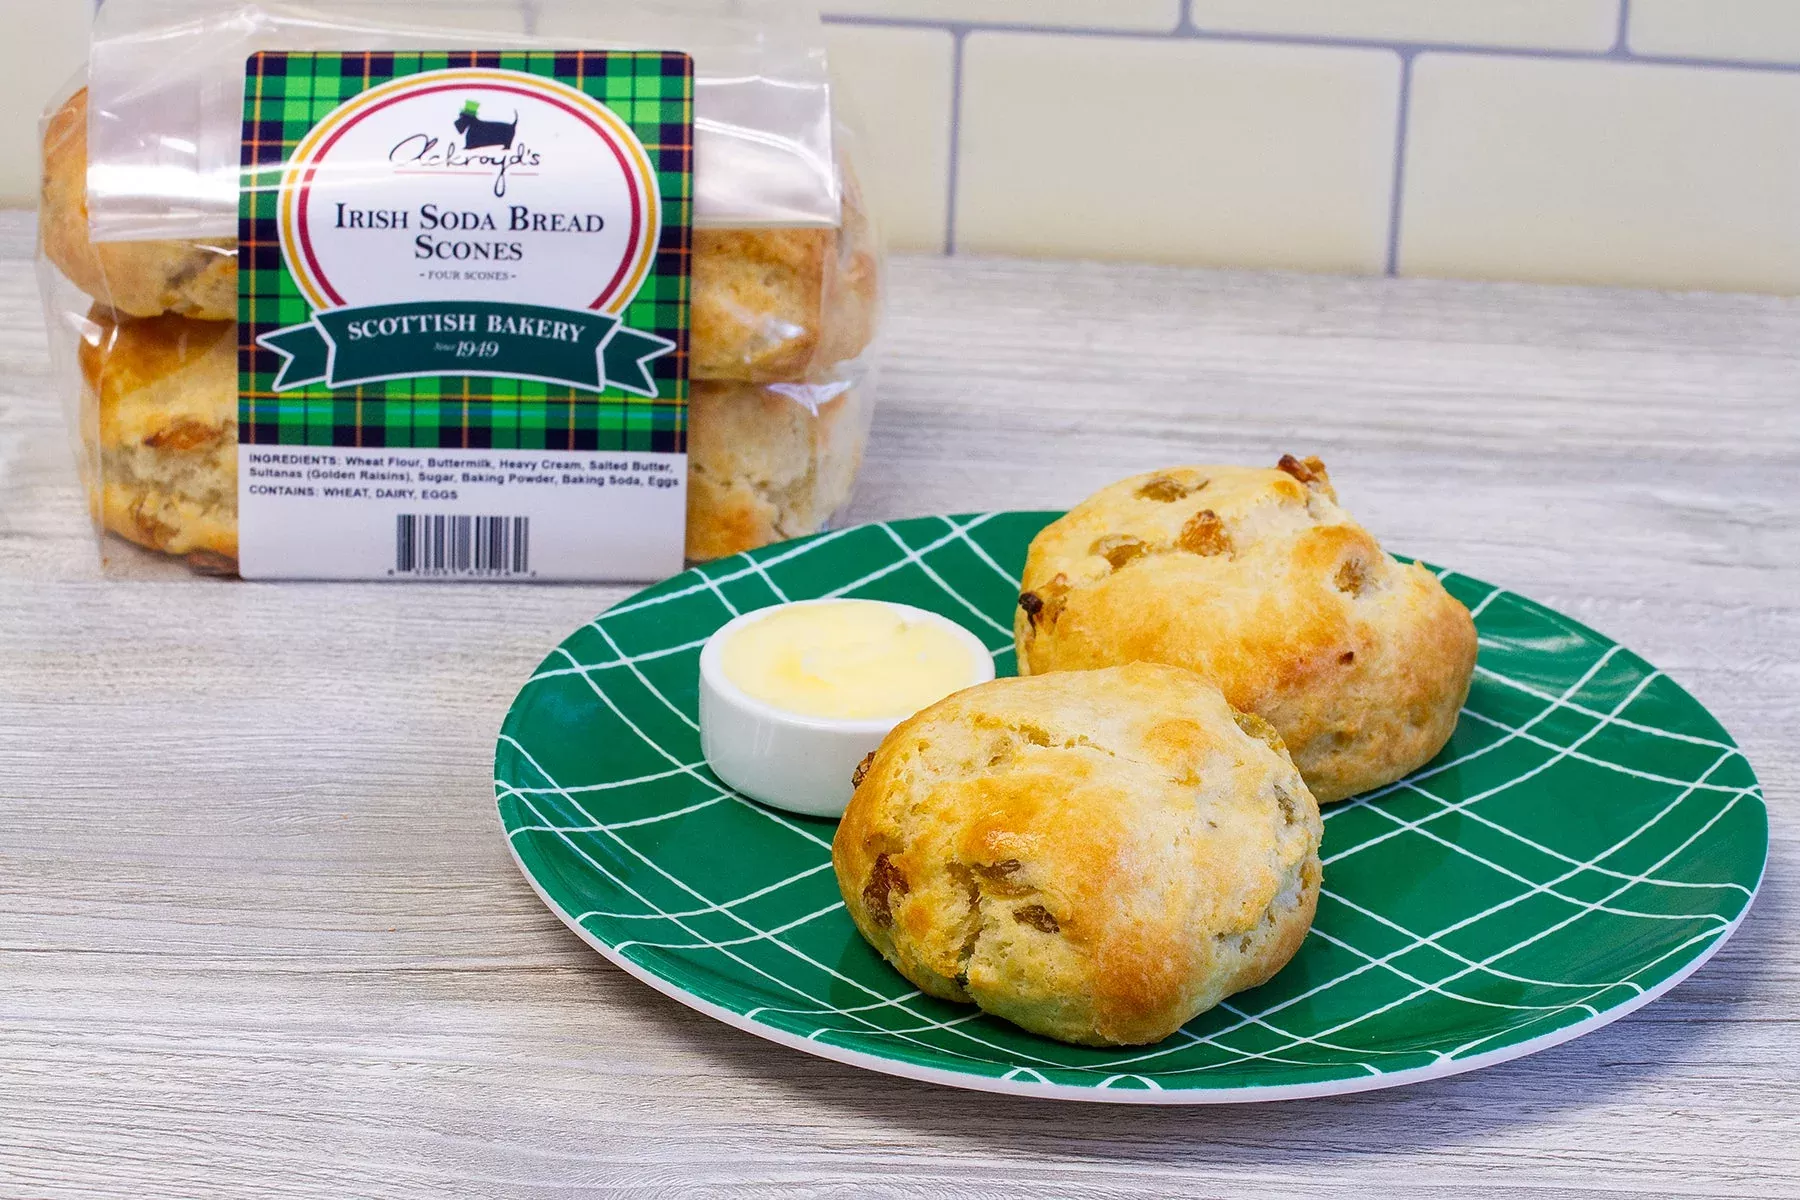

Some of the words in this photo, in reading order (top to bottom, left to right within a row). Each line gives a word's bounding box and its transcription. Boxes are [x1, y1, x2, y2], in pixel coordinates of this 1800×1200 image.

[389, 133, 541, 198] Ackroyd's
[334, 203, 408, 230] IRISH
[419, 203, 496, 231] SODA
[509, 205, 604, 233] BREAD
[415, 234, 523, 261] SCONES
[347, 313, 477, 341] SCOTTISH
[487, 314, 587, 343] BAKERY
[456, 340, 499, 358] 1949
[249, 453, 341, 466] INGREDIENTS:
[346, 456, 384, 467] Wheat
[388, 456, 425, 469] Flour,
[428, 457, 495, 470] Buttermilk,
[500, 459, 537, 471] Heavy
[541, 459, 585, 471] Cream,
[589, 460, 628, 471] Salted
[632, 461, 674, 473] Butter,
[249, 468, 303, 478] Sultanas
[307, 469, 355, 481] (Golden
[360, 470, 414, 483] Raisins),
[418, 471, 457, 484] Sugar,
[462, 473, 504, 485] Baking
[508, 473, 559, 486] Powder,
[562, 474, 605, 487] Baking
[609, 475, 644, 487] Soda,
[648, 476, 680, 488] Eggs
[249, 485, 319, 497] CONTAINS:
[324, 486, 372, 499] WHEAT,
[376, 488, 417, 500] DAIRY,
[421, 489, 459, 500] EGGS
